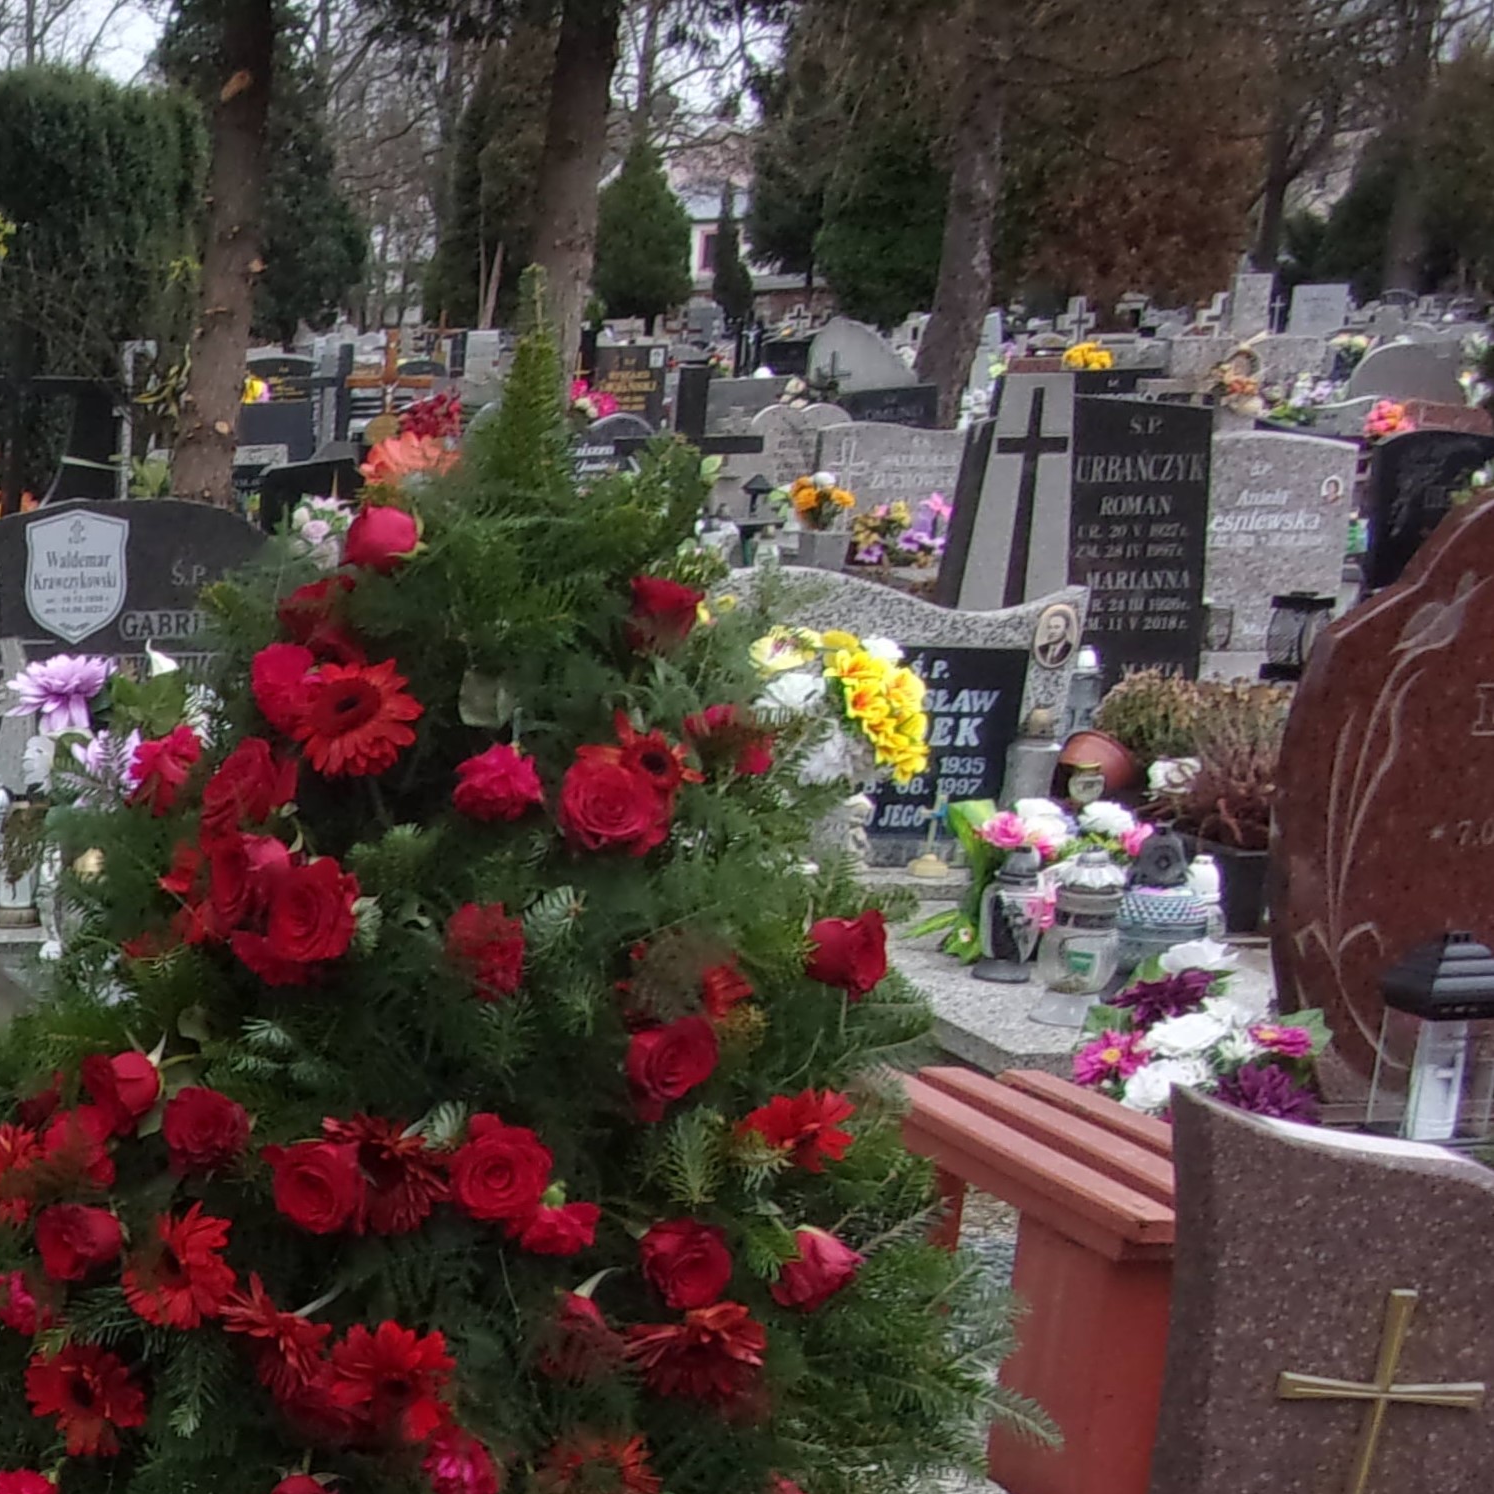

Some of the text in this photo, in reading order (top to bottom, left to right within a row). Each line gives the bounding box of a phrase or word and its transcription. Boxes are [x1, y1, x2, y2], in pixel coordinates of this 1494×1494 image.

[1076, 450, 1206, 483] URBAŃCZYK
[1099, 495, 1173, 516] ROMAN
[1211, 511, 1321, 532] eśniewska
[1086, 570, 1191, 590] MARIANNA
[939, 756, 987, 775] 1935
[935, 778, 984, 796] 1997
